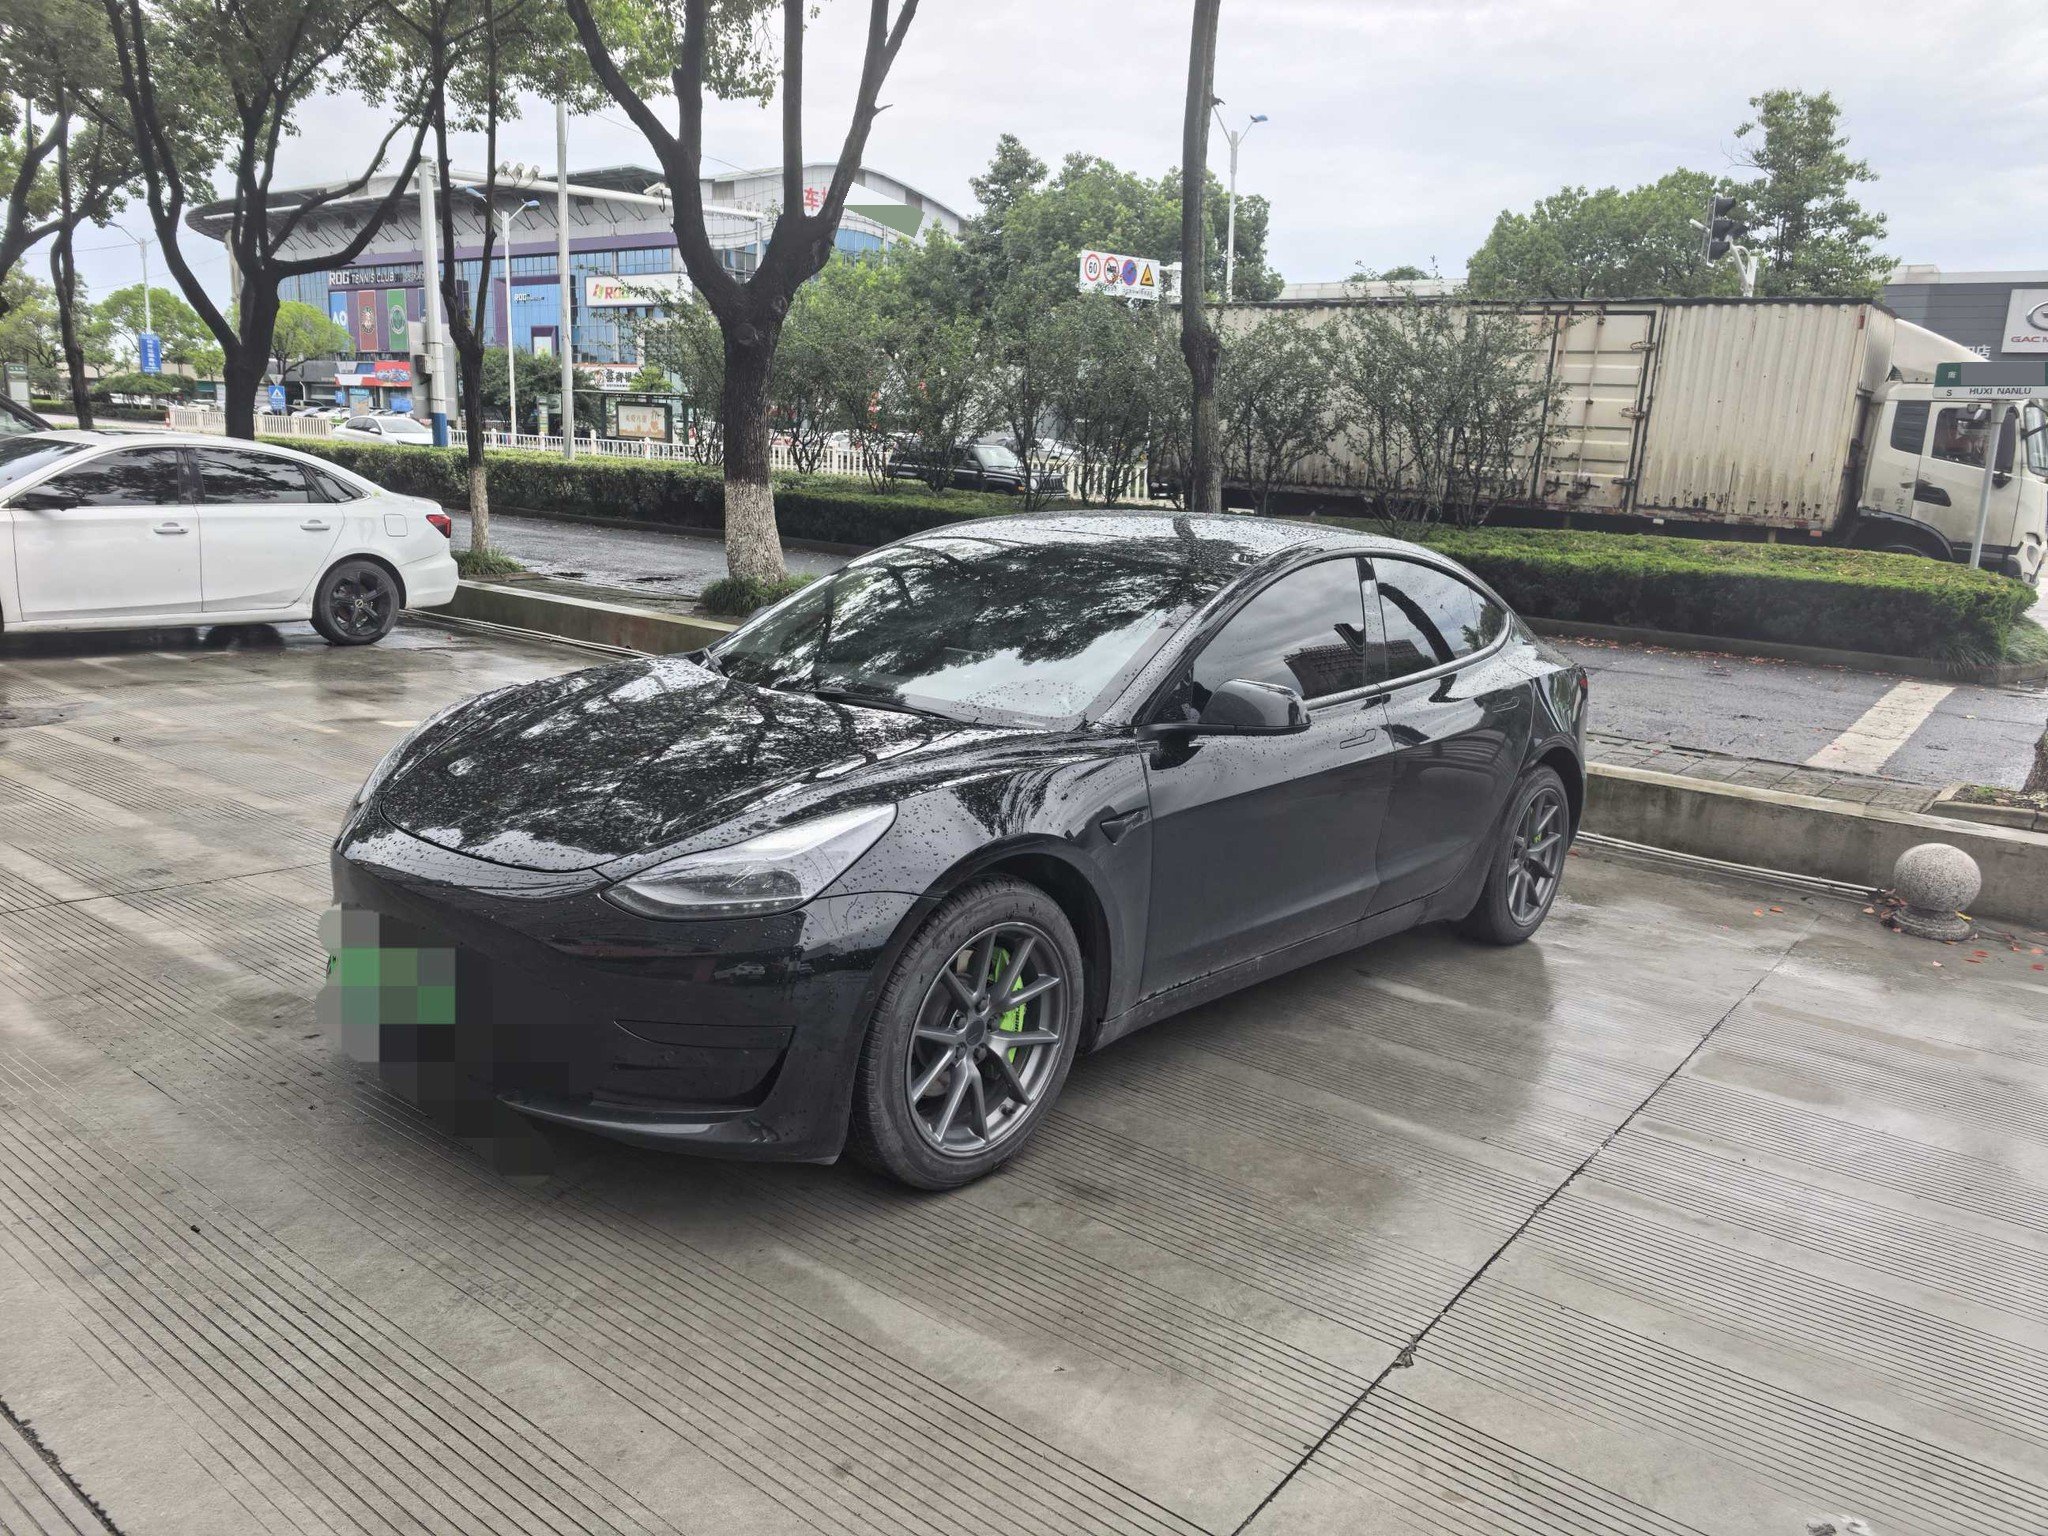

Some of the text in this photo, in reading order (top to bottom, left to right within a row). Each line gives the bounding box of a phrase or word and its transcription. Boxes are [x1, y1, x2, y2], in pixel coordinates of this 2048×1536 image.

[1088, 261, 1098, 274] 60
[329, 271, 349, 285] ROG
[351, 273, 375, 284] TENNIS
[376, 272, 395, 283] CLUB
[1946, 389, 1952, 397] S
[1969, 387, 2031, 395] HUXI NANLU
